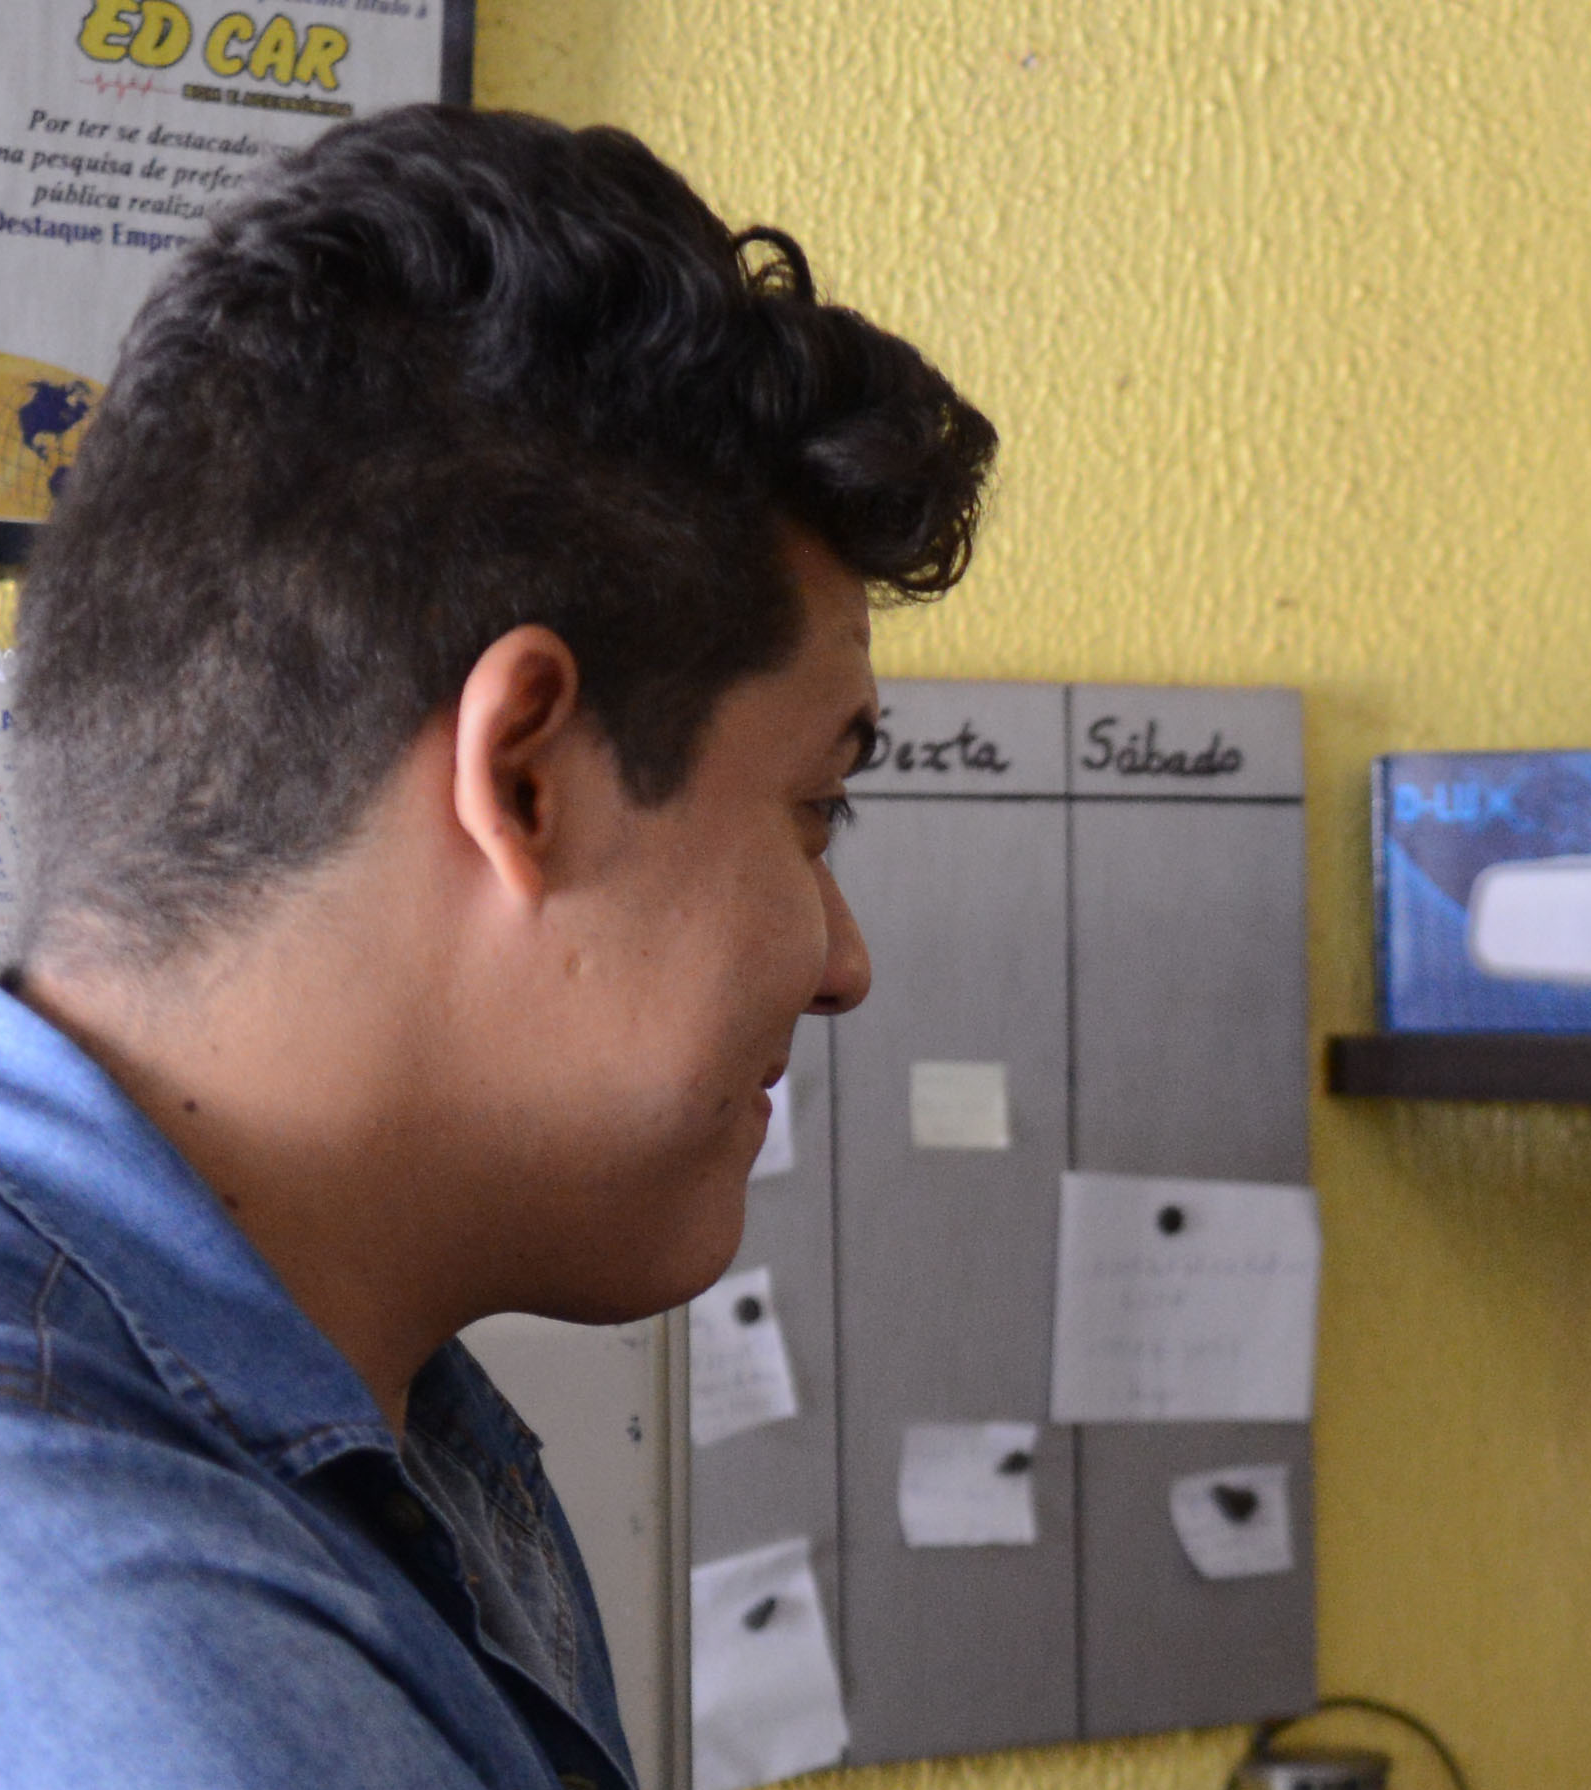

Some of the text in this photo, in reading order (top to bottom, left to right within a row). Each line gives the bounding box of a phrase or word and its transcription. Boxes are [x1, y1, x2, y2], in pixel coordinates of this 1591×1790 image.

[77, 0, 349, 91] ED CAR
[28, 108, 71, 133] Por
[77, 120, 109, 138] ter
[118, 125, 140, 143] se
[29, 149, 133, 177] pesquisa
[140, 157, 167, 181] de
[31, 182, 120, 208] pública
[1081, 714, 1243, 779] Sábado
